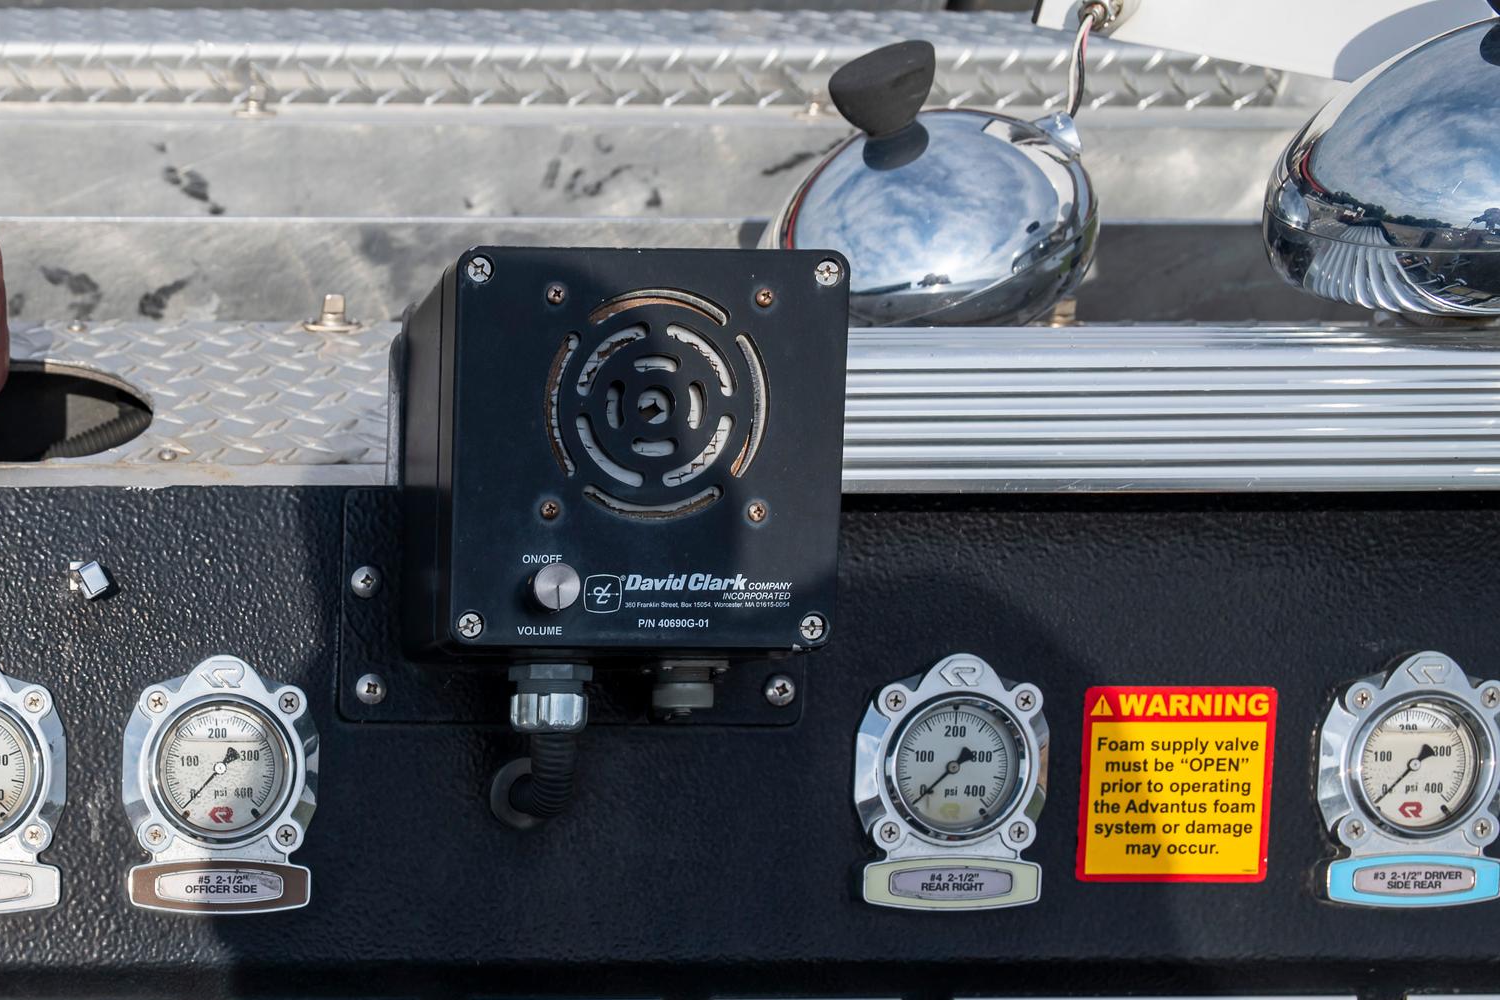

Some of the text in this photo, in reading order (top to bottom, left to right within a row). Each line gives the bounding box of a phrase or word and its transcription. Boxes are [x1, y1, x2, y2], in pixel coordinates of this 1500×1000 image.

[522, 555, 562, 563] ON/OFF
[625, 574, 687, 590] David
[688, 573, 747, 590] Clark
[723, 592, 790, 600] INCORPORATED
[638, 619, 709, 628] P/N 40690G-01
[517, 627, 562, 635] VOLUME
[1119, 694, 1269, 716] WARNING
[1098, 737, 1259, 754] Foam supply valve
[1106, 759, 1148, 772] must
[1154, 758, 1174, 772] be
[1101, 779, 1251, 795] prior to operating
[1094, 800, 1255, 813] the Advantus foam
[1095, 821, 1252, 837] system or damage
[1126, 843, 1219, 858] may occur.
[930, 874, 942, 882] #4
[1374, 872, 1385, 880] #3
[1425, 871, 1462, 880] DRIVER
[185, 885, 257, 893] OFFICER SIDE
[921, 883, 984, 891] REAR RIGHT
[1387, 881, 1441, 889] SIDE REAR
